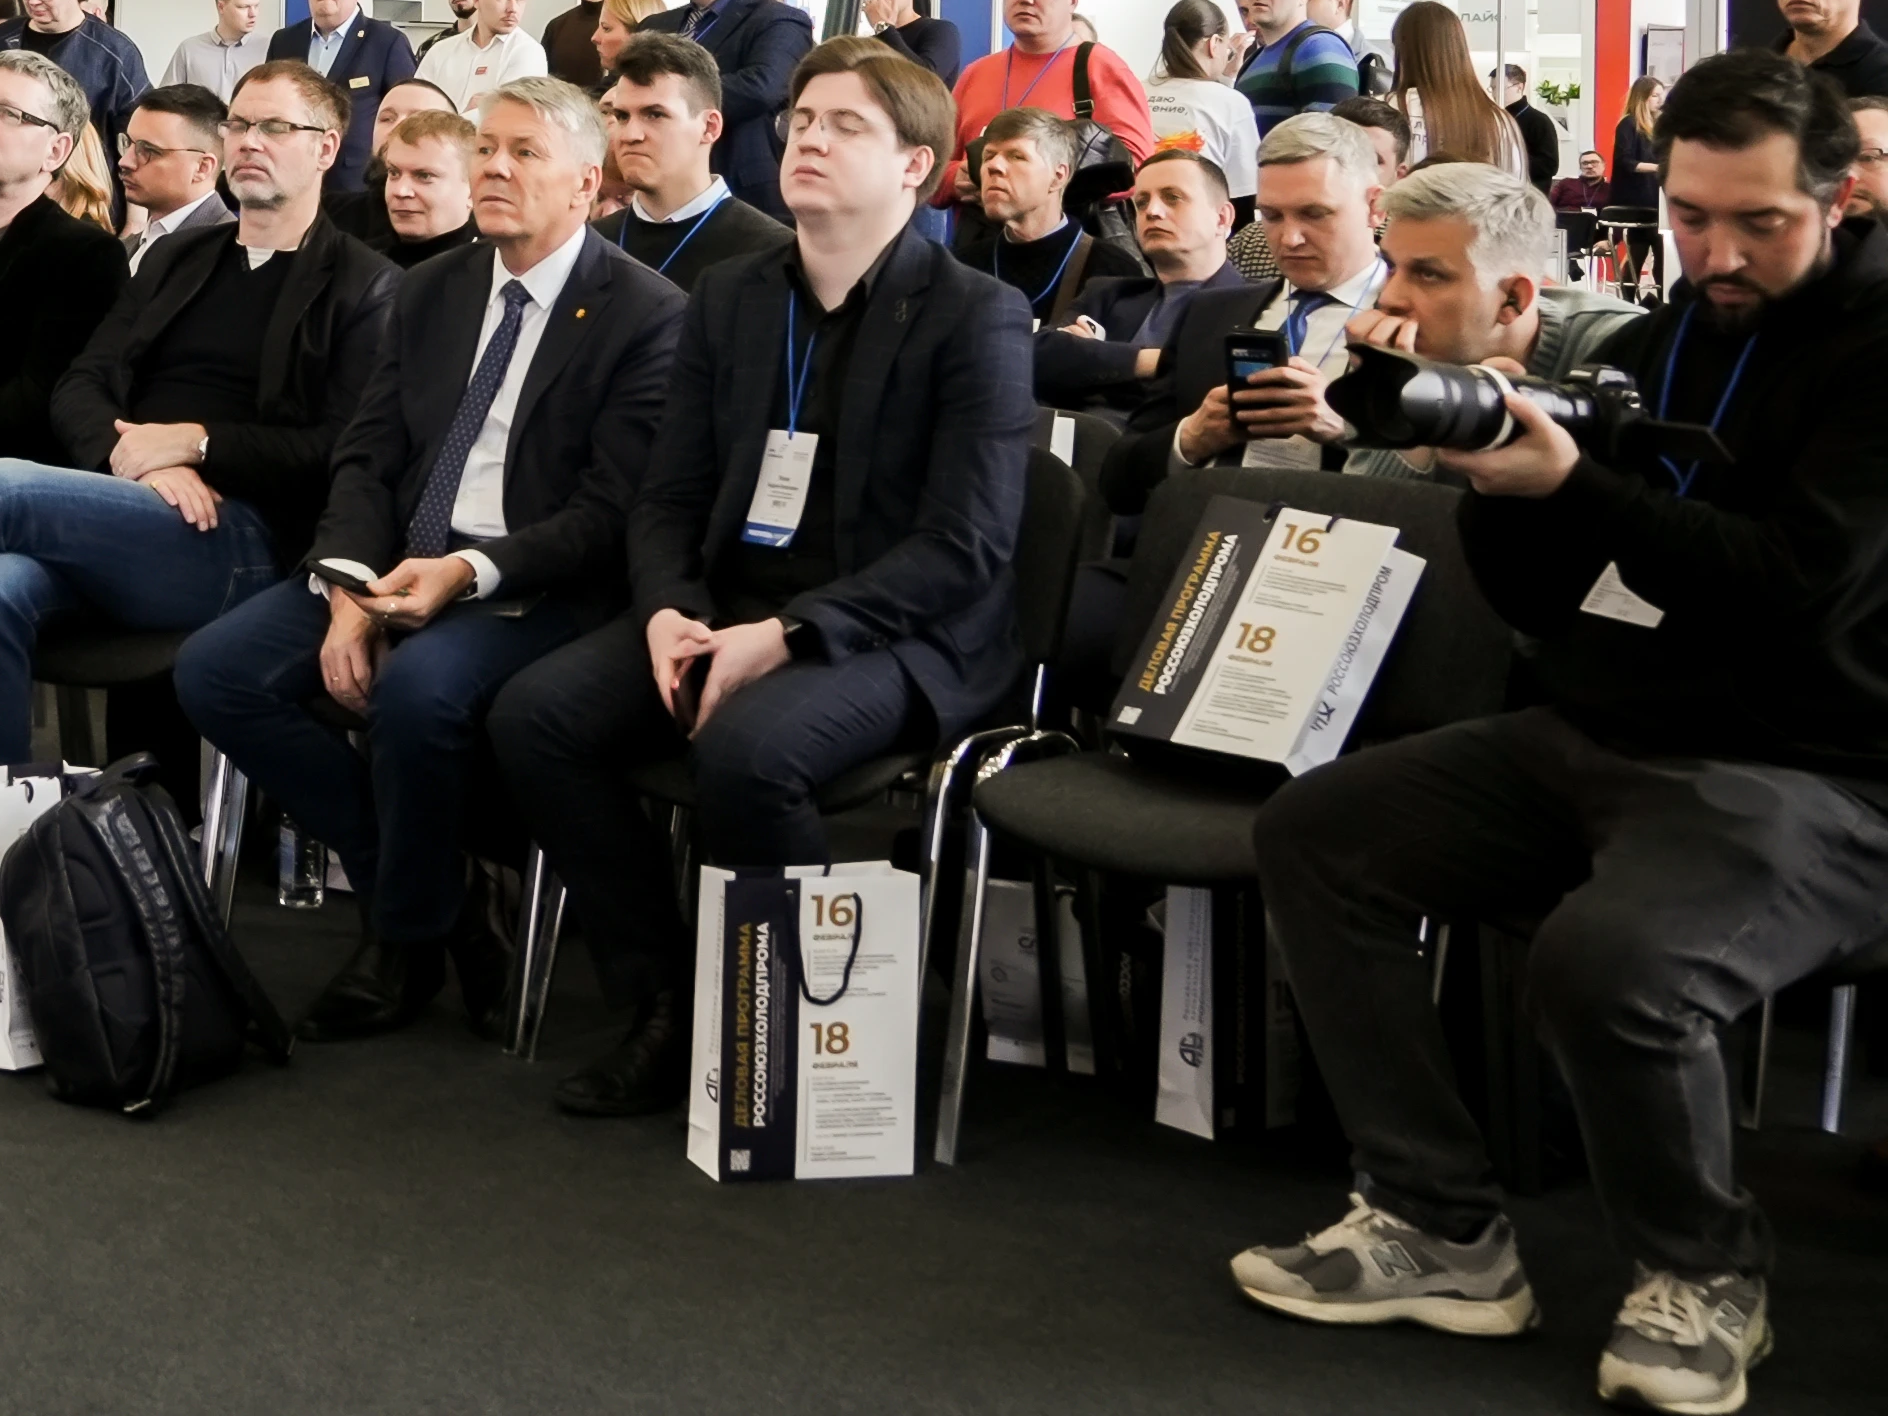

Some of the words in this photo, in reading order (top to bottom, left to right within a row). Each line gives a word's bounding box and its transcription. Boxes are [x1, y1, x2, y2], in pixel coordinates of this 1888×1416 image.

[1280, 523, 1326, 554] 16
[1138, 621, 1178, 692] ДЕЛОВАЯ
[1173, 530, 1221, 621] ПРОГРАММА
[1153, 534, 1238, 695] РОССОЮЗХОЛОДПРОМА
[1235, 621, 1276, 654] 18
[1327, 565, 1393, 697] РОССОЮЗХОЛОДПРОМ
[810, 893, 854, 927] 16
[737, 922, 753, 1037] ПРОГРАММА
[753, 922, 770, 1127] РОССОЮЗХОЛОДПРОМА
[733, 1039, 751, 1128] ДЕЛОВАЯ
[809, 1020, 850, 1056] 18
